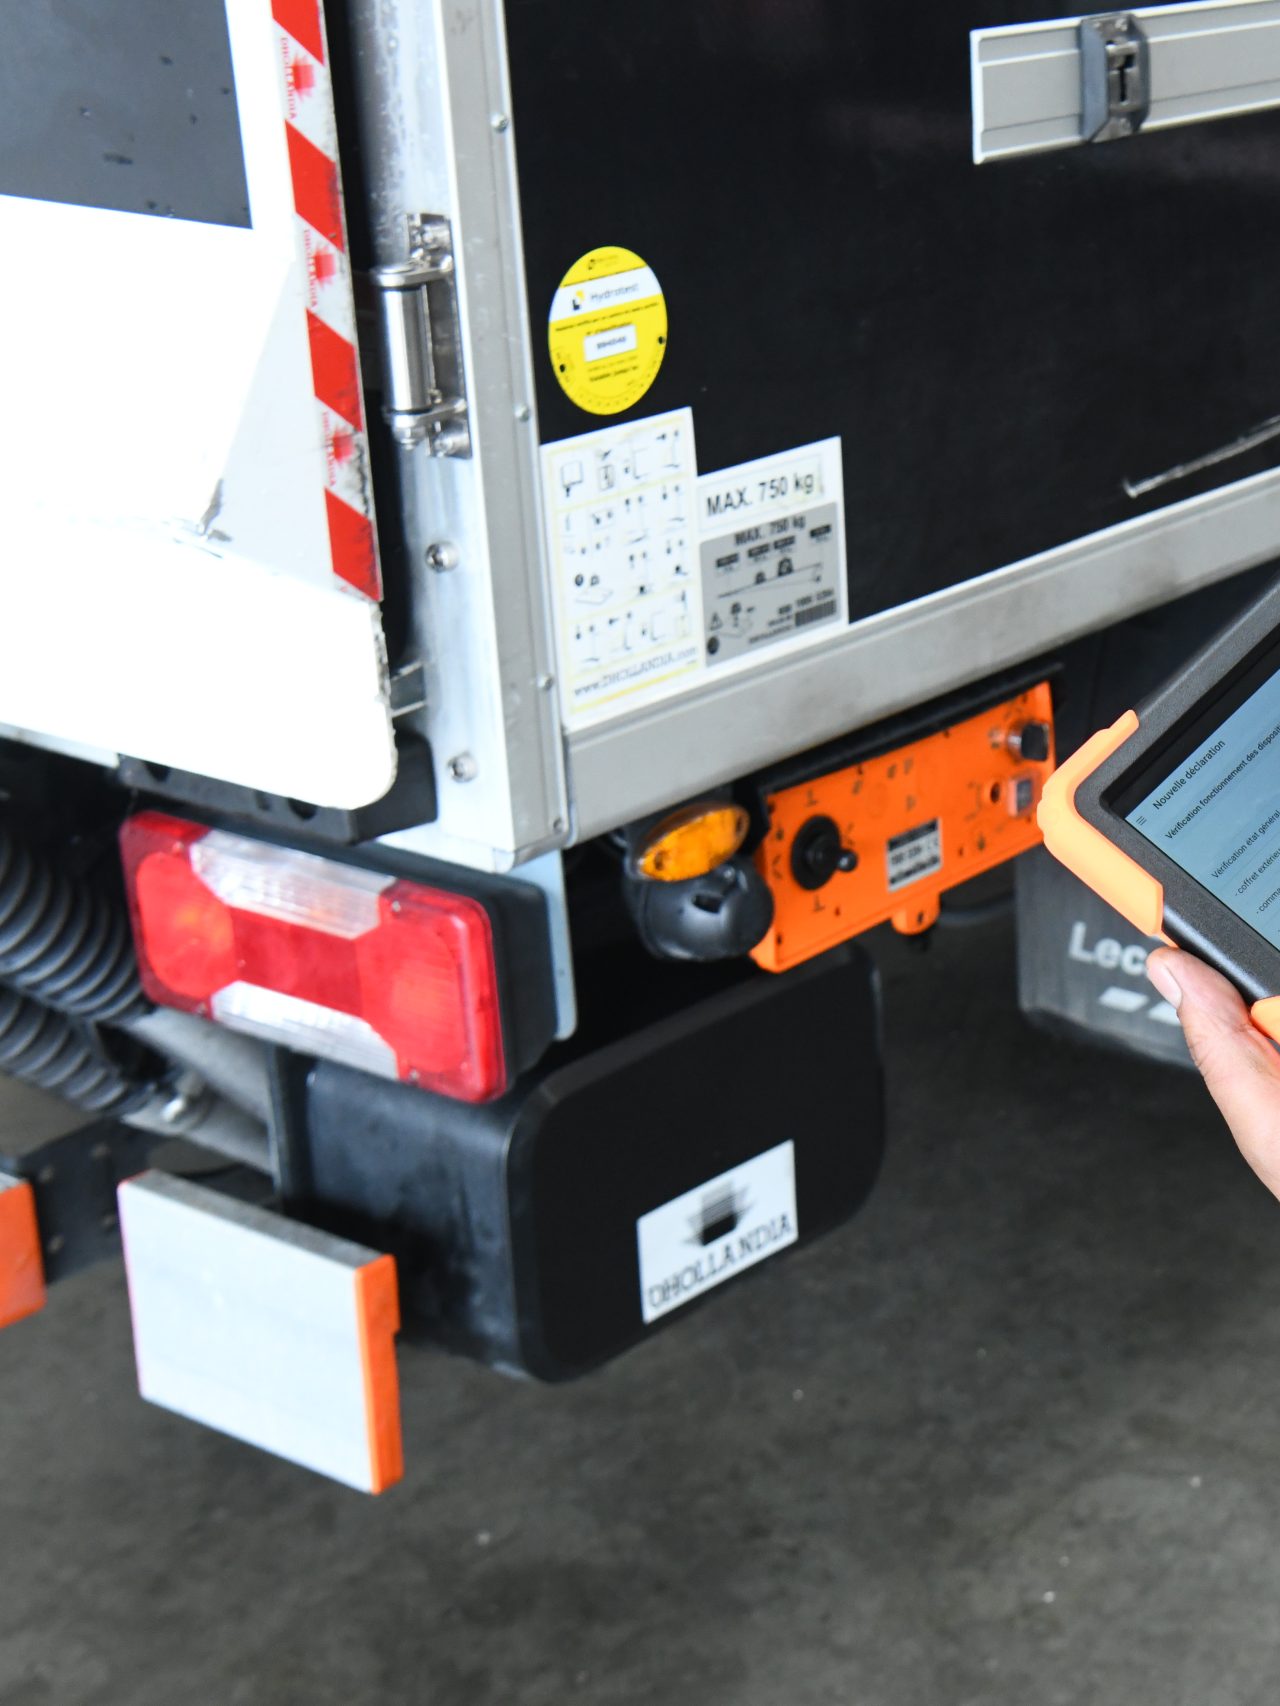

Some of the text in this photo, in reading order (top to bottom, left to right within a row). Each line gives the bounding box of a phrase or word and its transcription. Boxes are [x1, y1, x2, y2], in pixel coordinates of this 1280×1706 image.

[707, 472, 814, 516] MAX. 750 kg
[734, 524, 764, 546] MAX.
[769, 517, 789, 535] 750
[793, 515, 806, 529] kg
[1152, 740, 1226, 810] Nouvelle déclaration
[1164, 805, 1203, 839] Vérification
[1198, 759, 1249, 807] fonctionnement
[1210, 844, 1248, 879] Vérification
[1237, 871, 1260, 894] coffret
[1068, 921, 1148, 977] Lec
[649, 1212, 792, 1308] DHOLLANDIA
